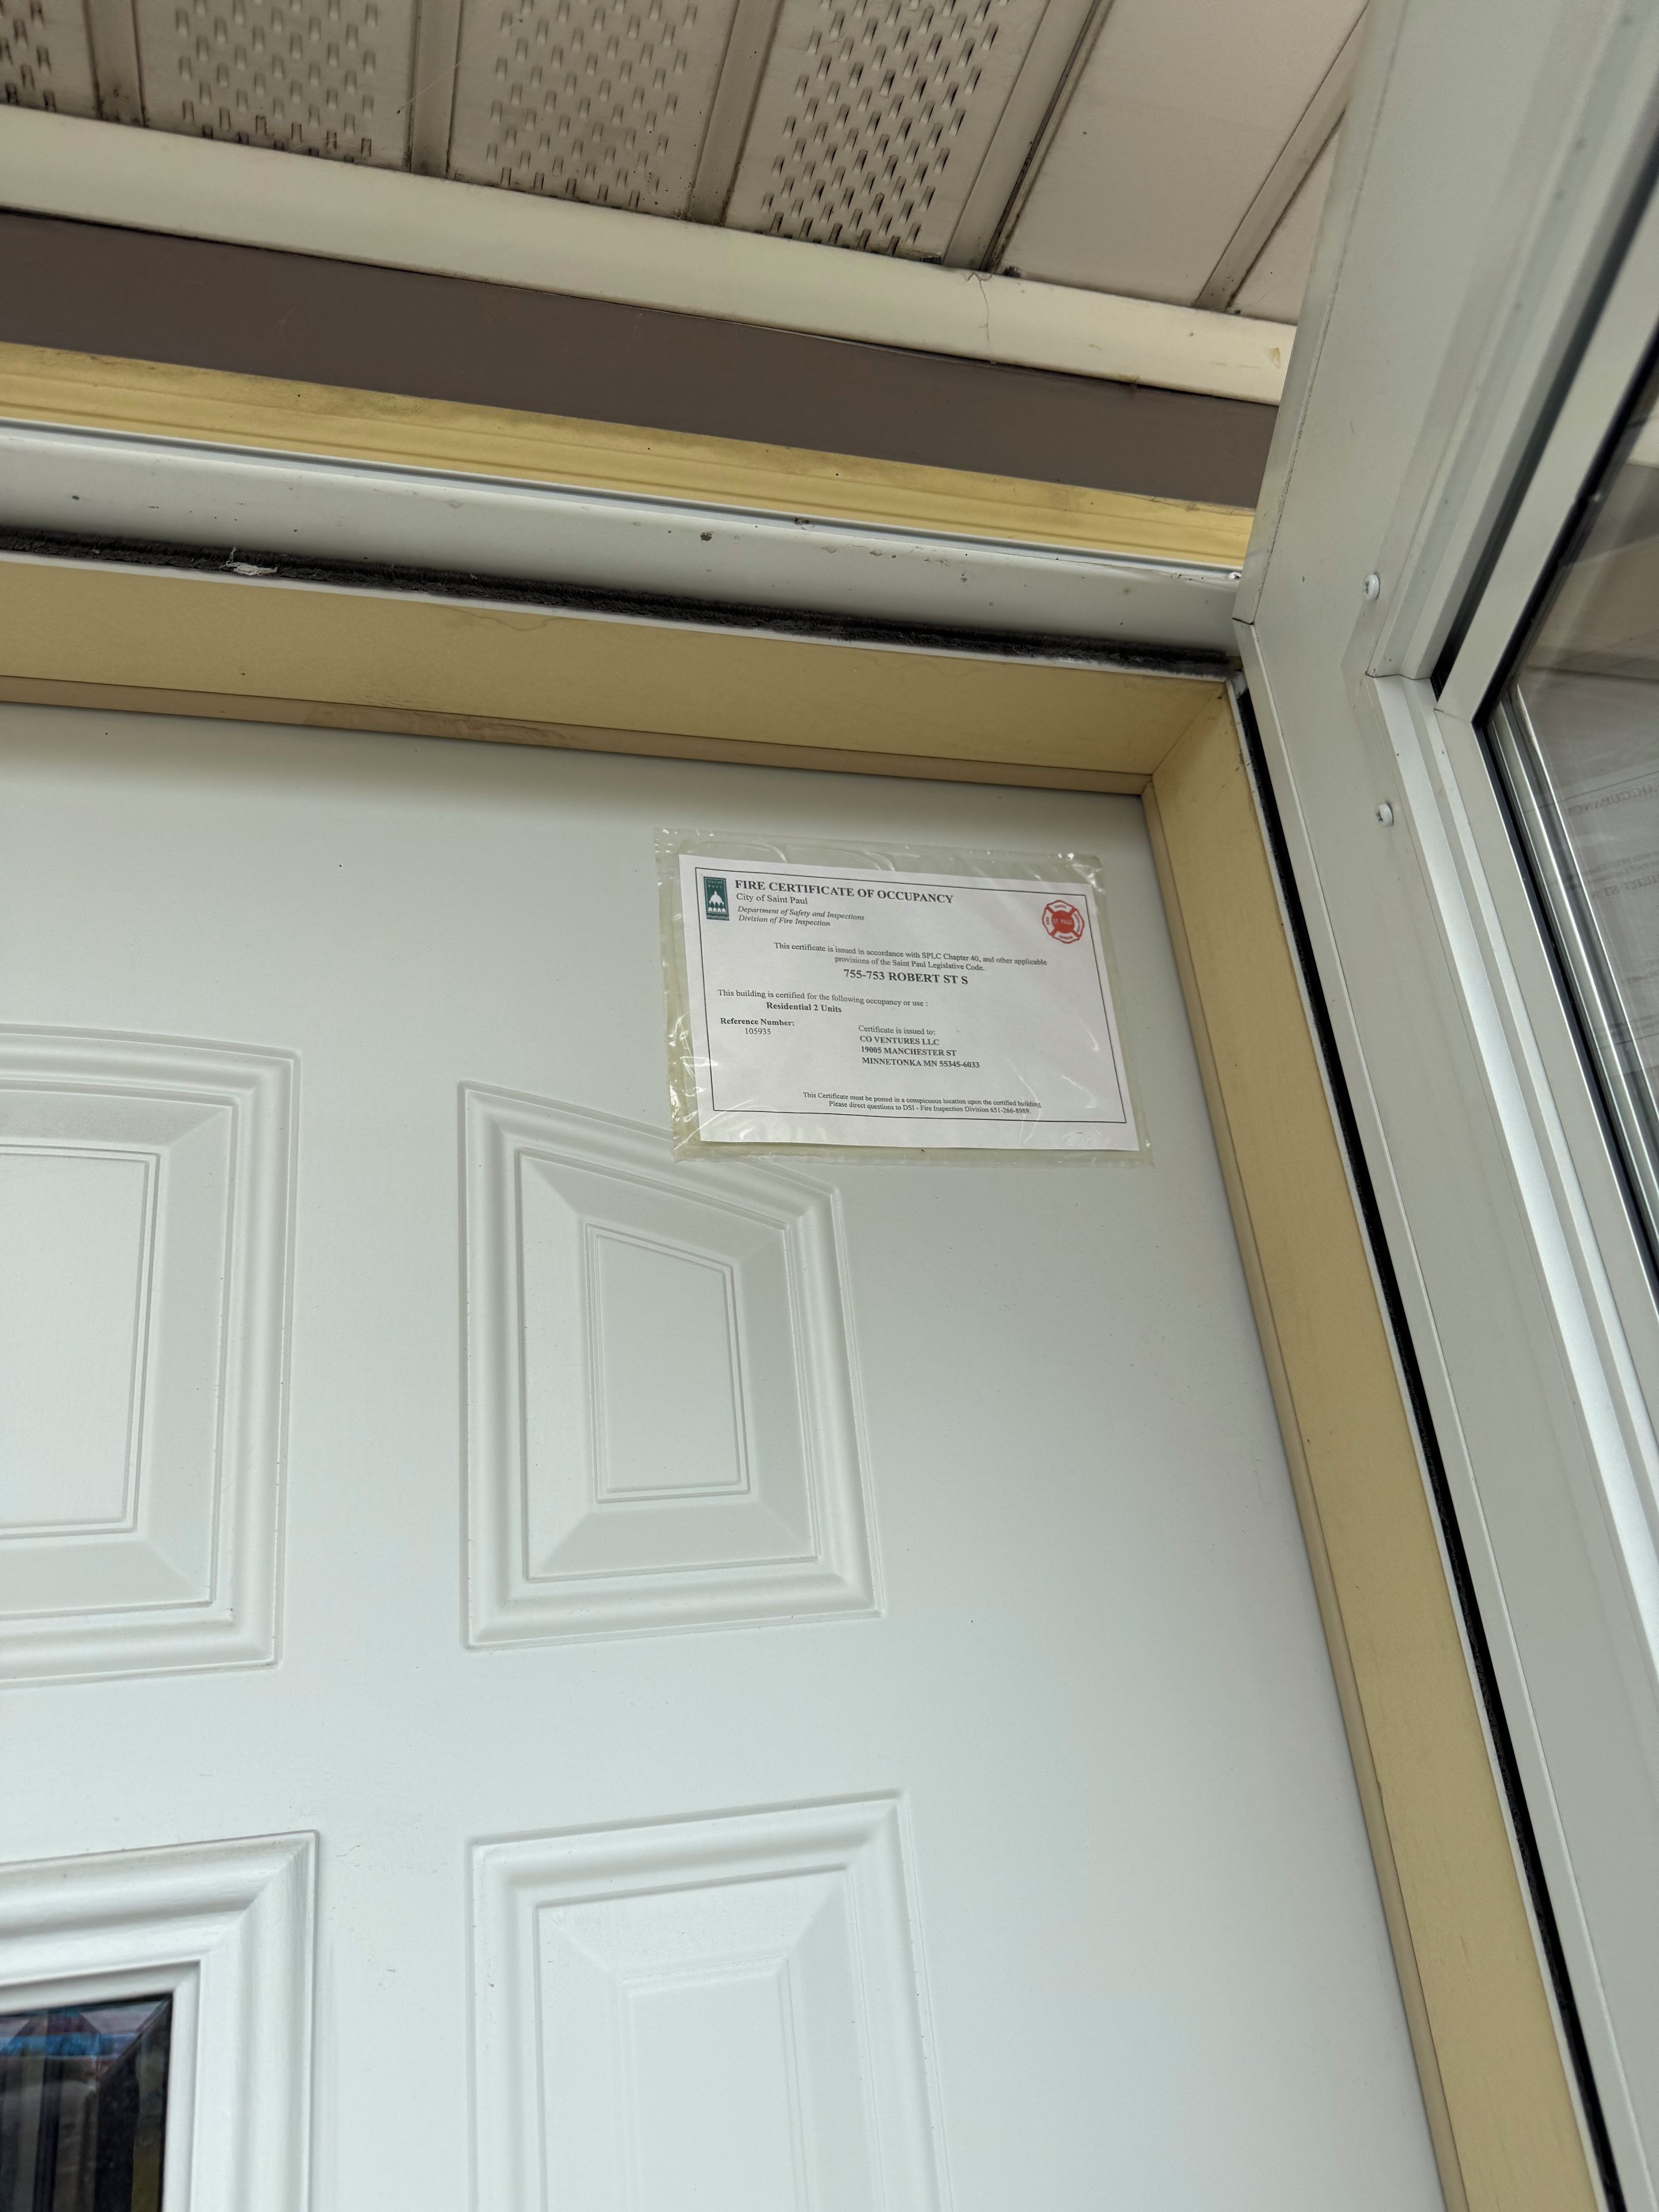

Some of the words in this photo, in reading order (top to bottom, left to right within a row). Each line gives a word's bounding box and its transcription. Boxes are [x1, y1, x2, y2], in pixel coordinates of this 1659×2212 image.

[735, 880, 766, 890] FIRE
[769, 882, 854, 896] CERTIFICATE
[857, 889, 874, 897] OF
[877, 890, 953, 903] OCCUPANCY
[736, 893, 753, 902] City
[767, 895, 787, 903] Saint
[790, 896, 808, 904] Paul
[738, 906, 778, 915] Department
[789, 909, 810, 917] Safety
[827, 911, 865, 921] Inspections
[795, 918, 830, 926] Inspection
[944, 953, 969, 961] Chapter
[843, 969, 885, 980] 755-753
[888, 972, 940, 983] ROBERT
[944, 975, 958, 984] ST
[961, 976, 968, 984] S
[736, 990, 766, 998] building
[832, 995, 864, 1005] following
[766, 1002, 812, 1011] Residential
[821, 1005, 842, 1013] Units
[760, 1018, 795, 1027] Number:
[858, 1025, 894, 1033] Certificate
[874, 1036, 920, 1045] VENTURES
[884, 1047, 945, 1056] MANCHESTER
[862, 1057, 922, 1066] MINNETONKA
[940, 1060, 980, 1069] 55345-6033
